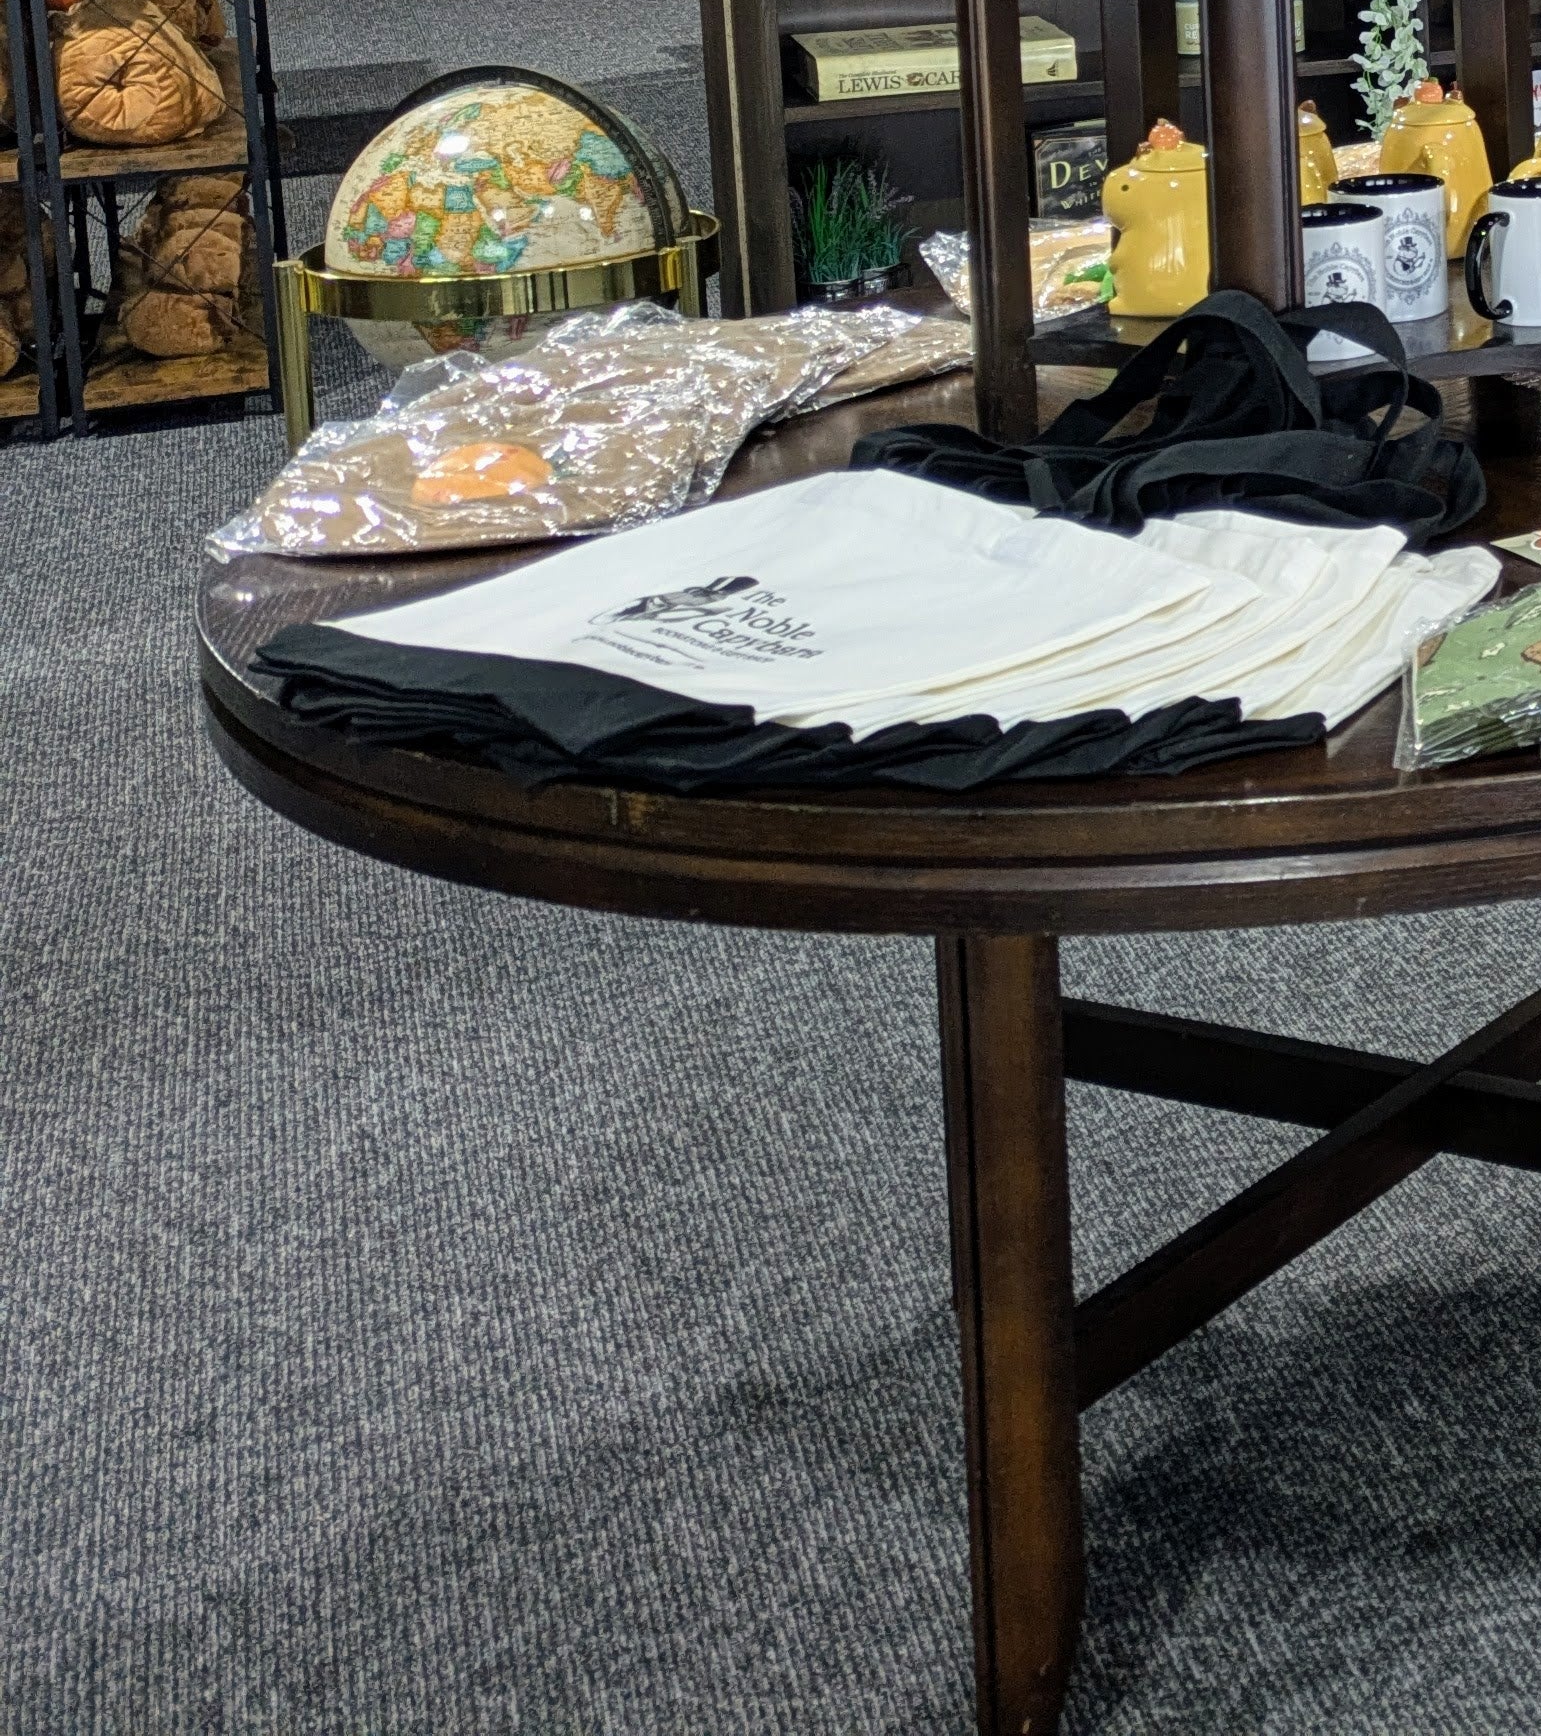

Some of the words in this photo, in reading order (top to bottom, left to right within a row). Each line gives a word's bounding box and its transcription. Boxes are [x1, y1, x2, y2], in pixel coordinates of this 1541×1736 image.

[838, 75, 901, 94] LEWIS
[742, 590, 786, 608] The
[726, 607, 816, 641] Noble
[692, 619, 826, 659] Capybara
